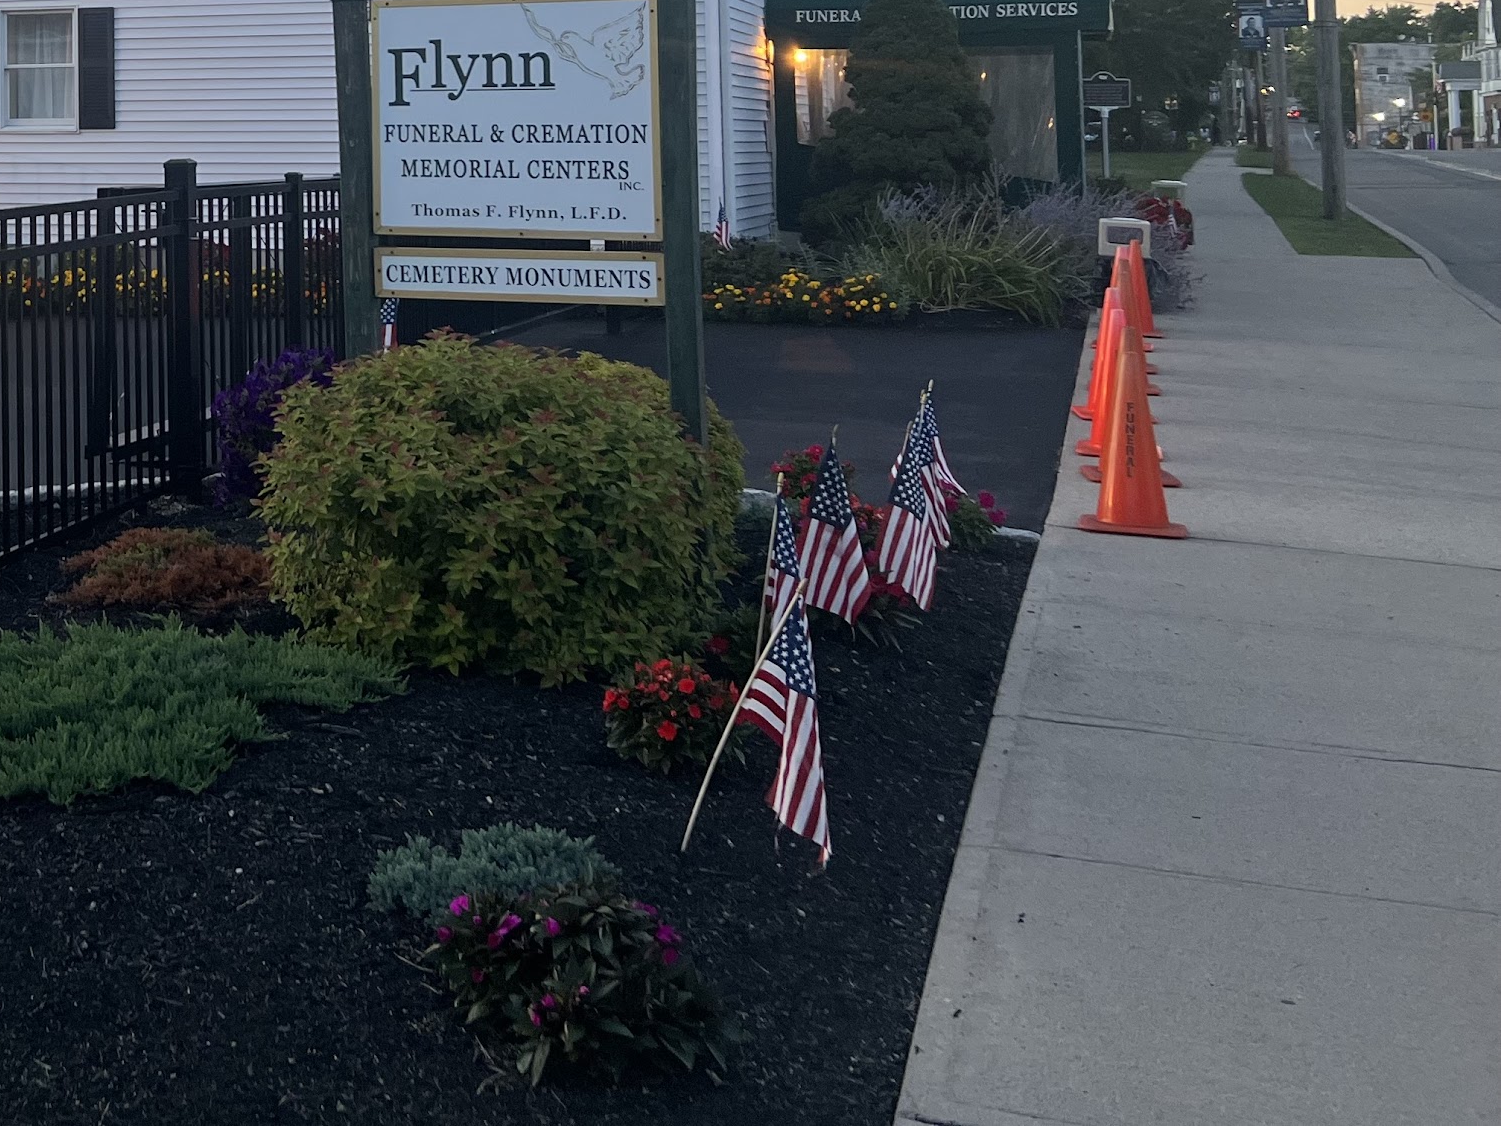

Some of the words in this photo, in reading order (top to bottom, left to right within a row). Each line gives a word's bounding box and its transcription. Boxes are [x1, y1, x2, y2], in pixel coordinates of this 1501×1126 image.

[796, 9, 862, 23] FUNERA
[996, 2, 1078, 17] SERVICES
[387, 39, 556, 106] Flynn
[384, 124, 483, 143] FUNERAL
[490, 124, 505, 143] &
[511, 124, 648, 144] CREMATION
[401, 159, 520, 179] MEMORIAL
[527, 160, 630, 180] CENTERS
[619, 181, 645, 191] INC.
[411, 203, 480, 218] Thomas
[486, 205, 502, 218] F.
[508, 205, 565, 221] Flynn,
[571, 206, 627, 221] L.F.D.
[386, 264, 500, 285] CEMETERY
[506, 267, 652, 290] MONUMENTS
[1125, 402, 1136, 478] FUNERAL
